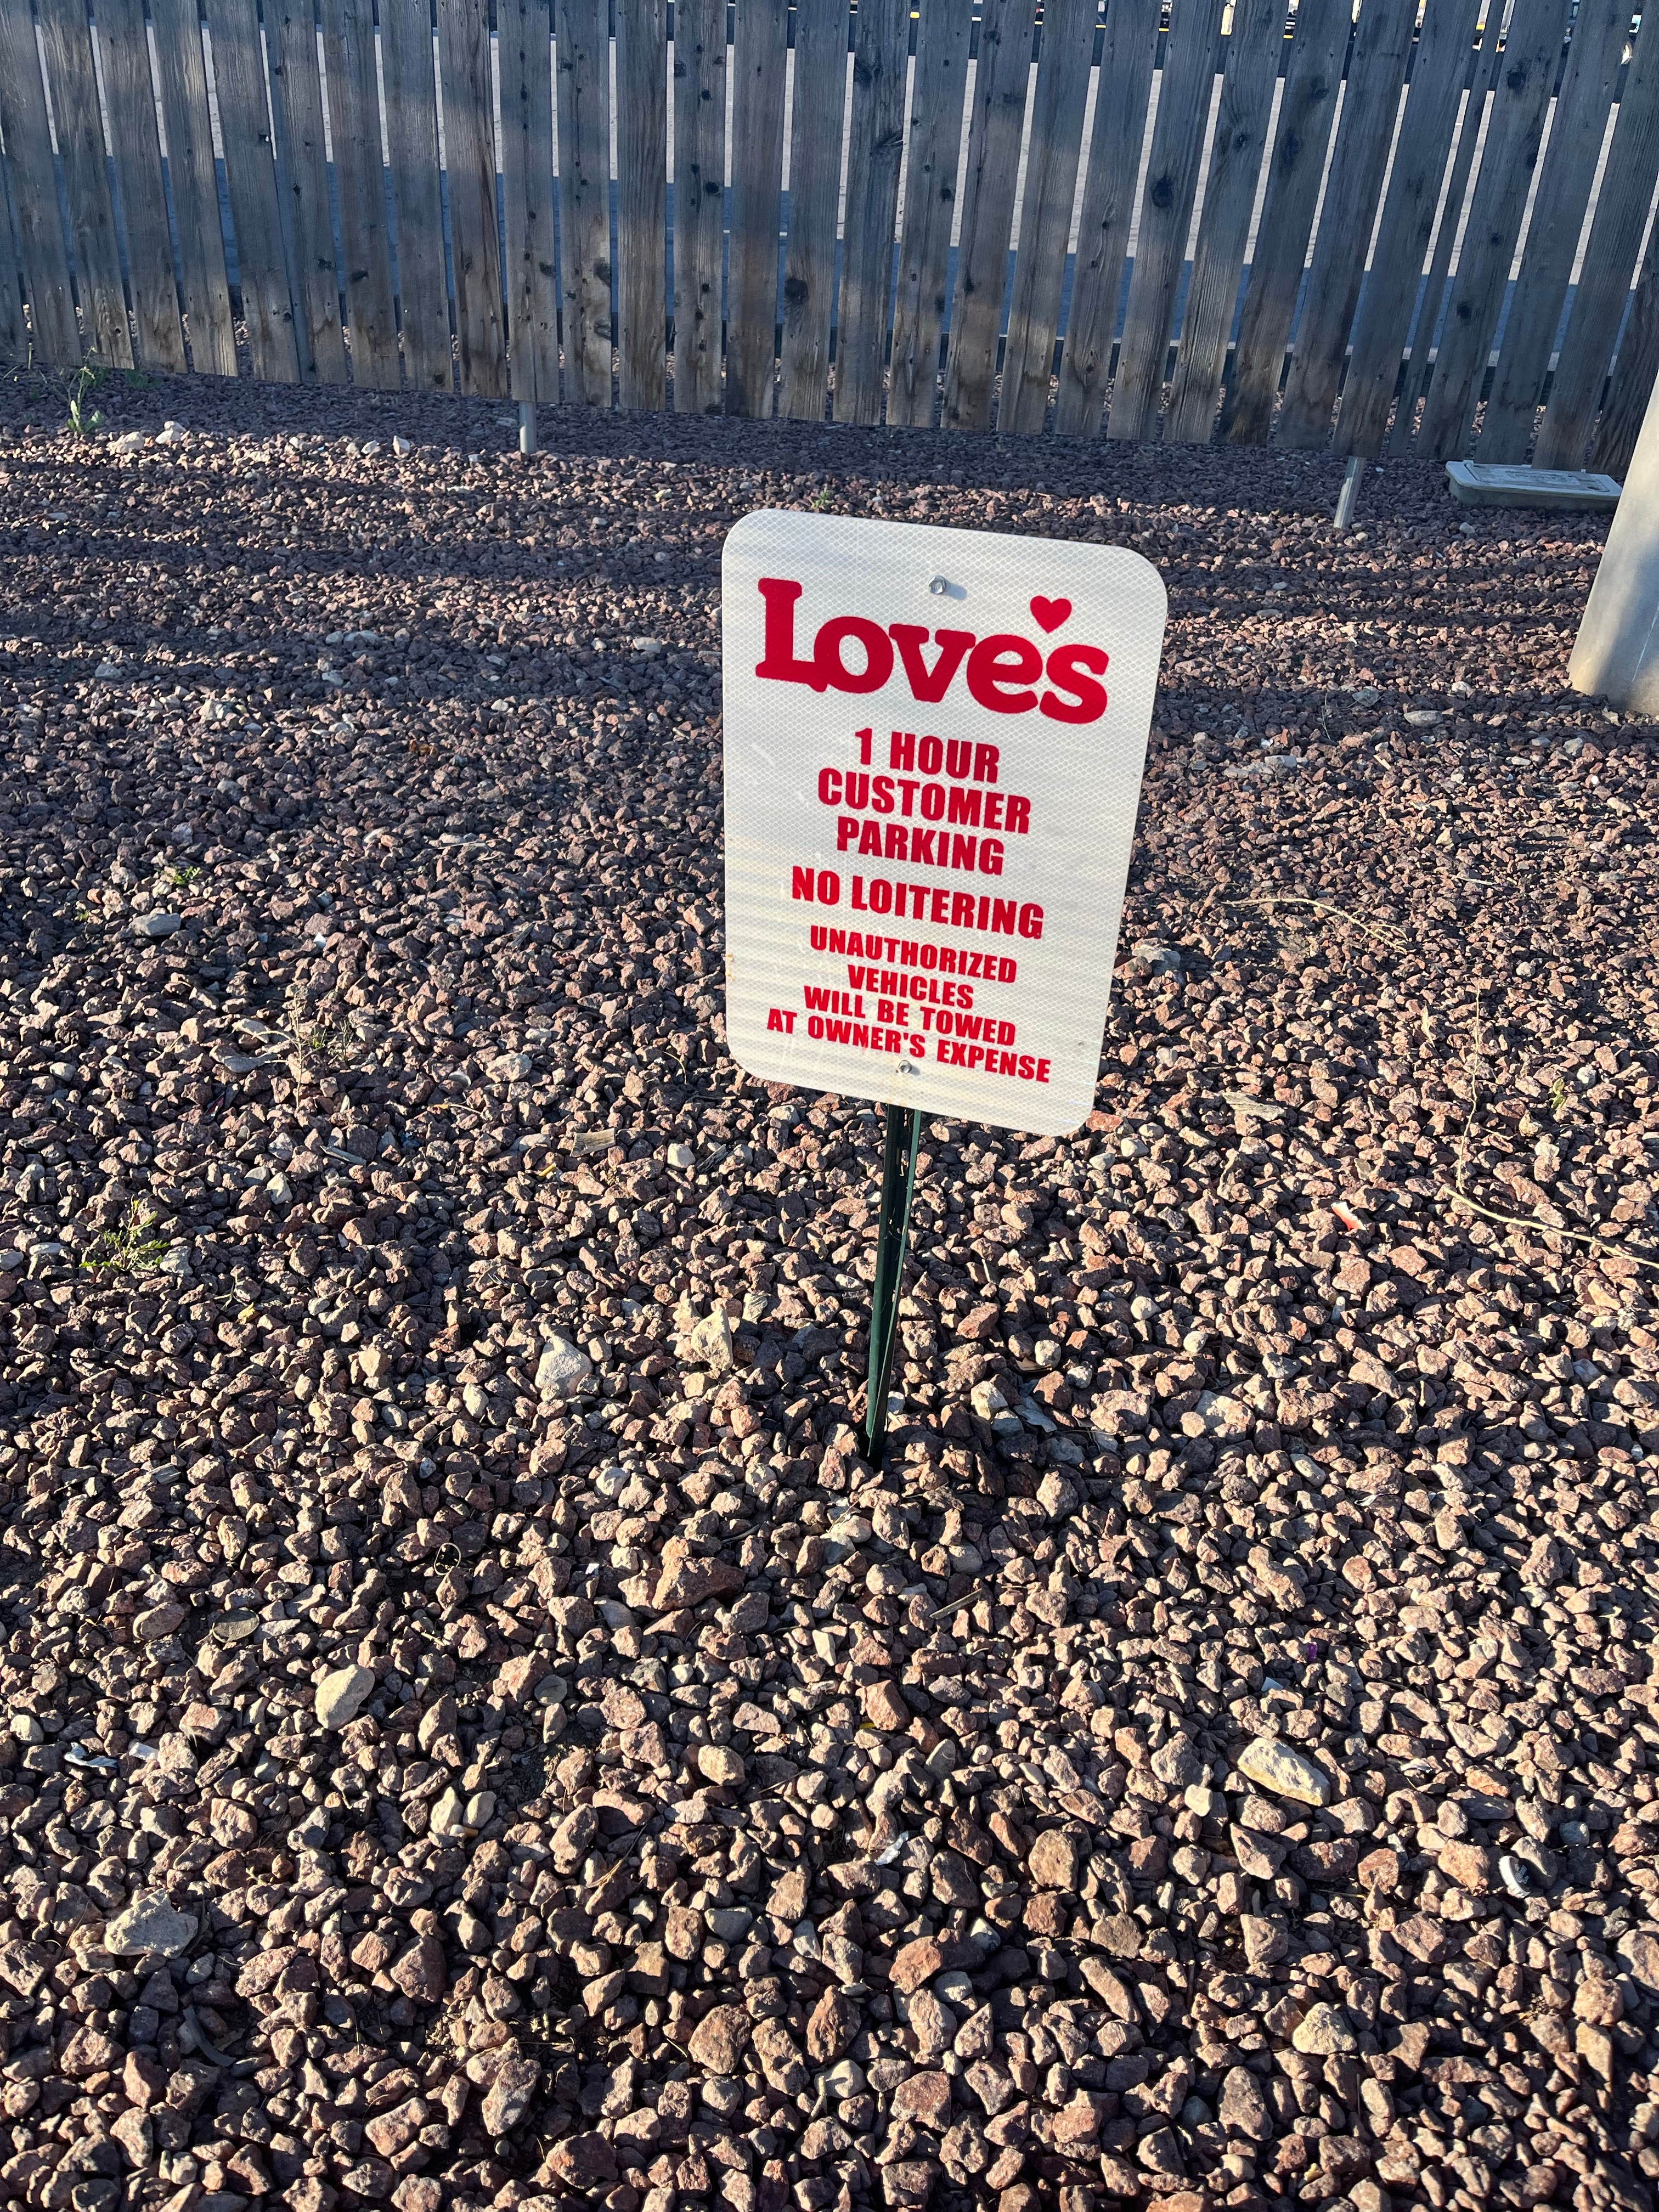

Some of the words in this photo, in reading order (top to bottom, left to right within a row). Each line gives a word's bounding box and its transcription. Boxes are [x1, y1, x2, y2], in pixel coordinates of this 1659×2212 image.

[855, 728, 872, 765] 1
[890, 731, 1000, 783] HOUR
[819, 768, 1031, 834] CUSTOMER
[837, 816, 1004, 875] PARKING
[792, 866, 840, 906] NO
[851, 876, 1044, 939] LOITERING
[810, 925, 1017, 983] UNAUTHORIZED
[804, 985, 866, 1018] WILL
[877, 998, 909, 1026] BE
[920, 1006, 1016, 1046] TOWED
[848, 964, 974, 1009] VEHICLES
[767, 1008, 797, 1034] AT
[808, 1015, 926, 1058] OWNER'S
[937, 1039, 1051, 1083] EXPENSE
